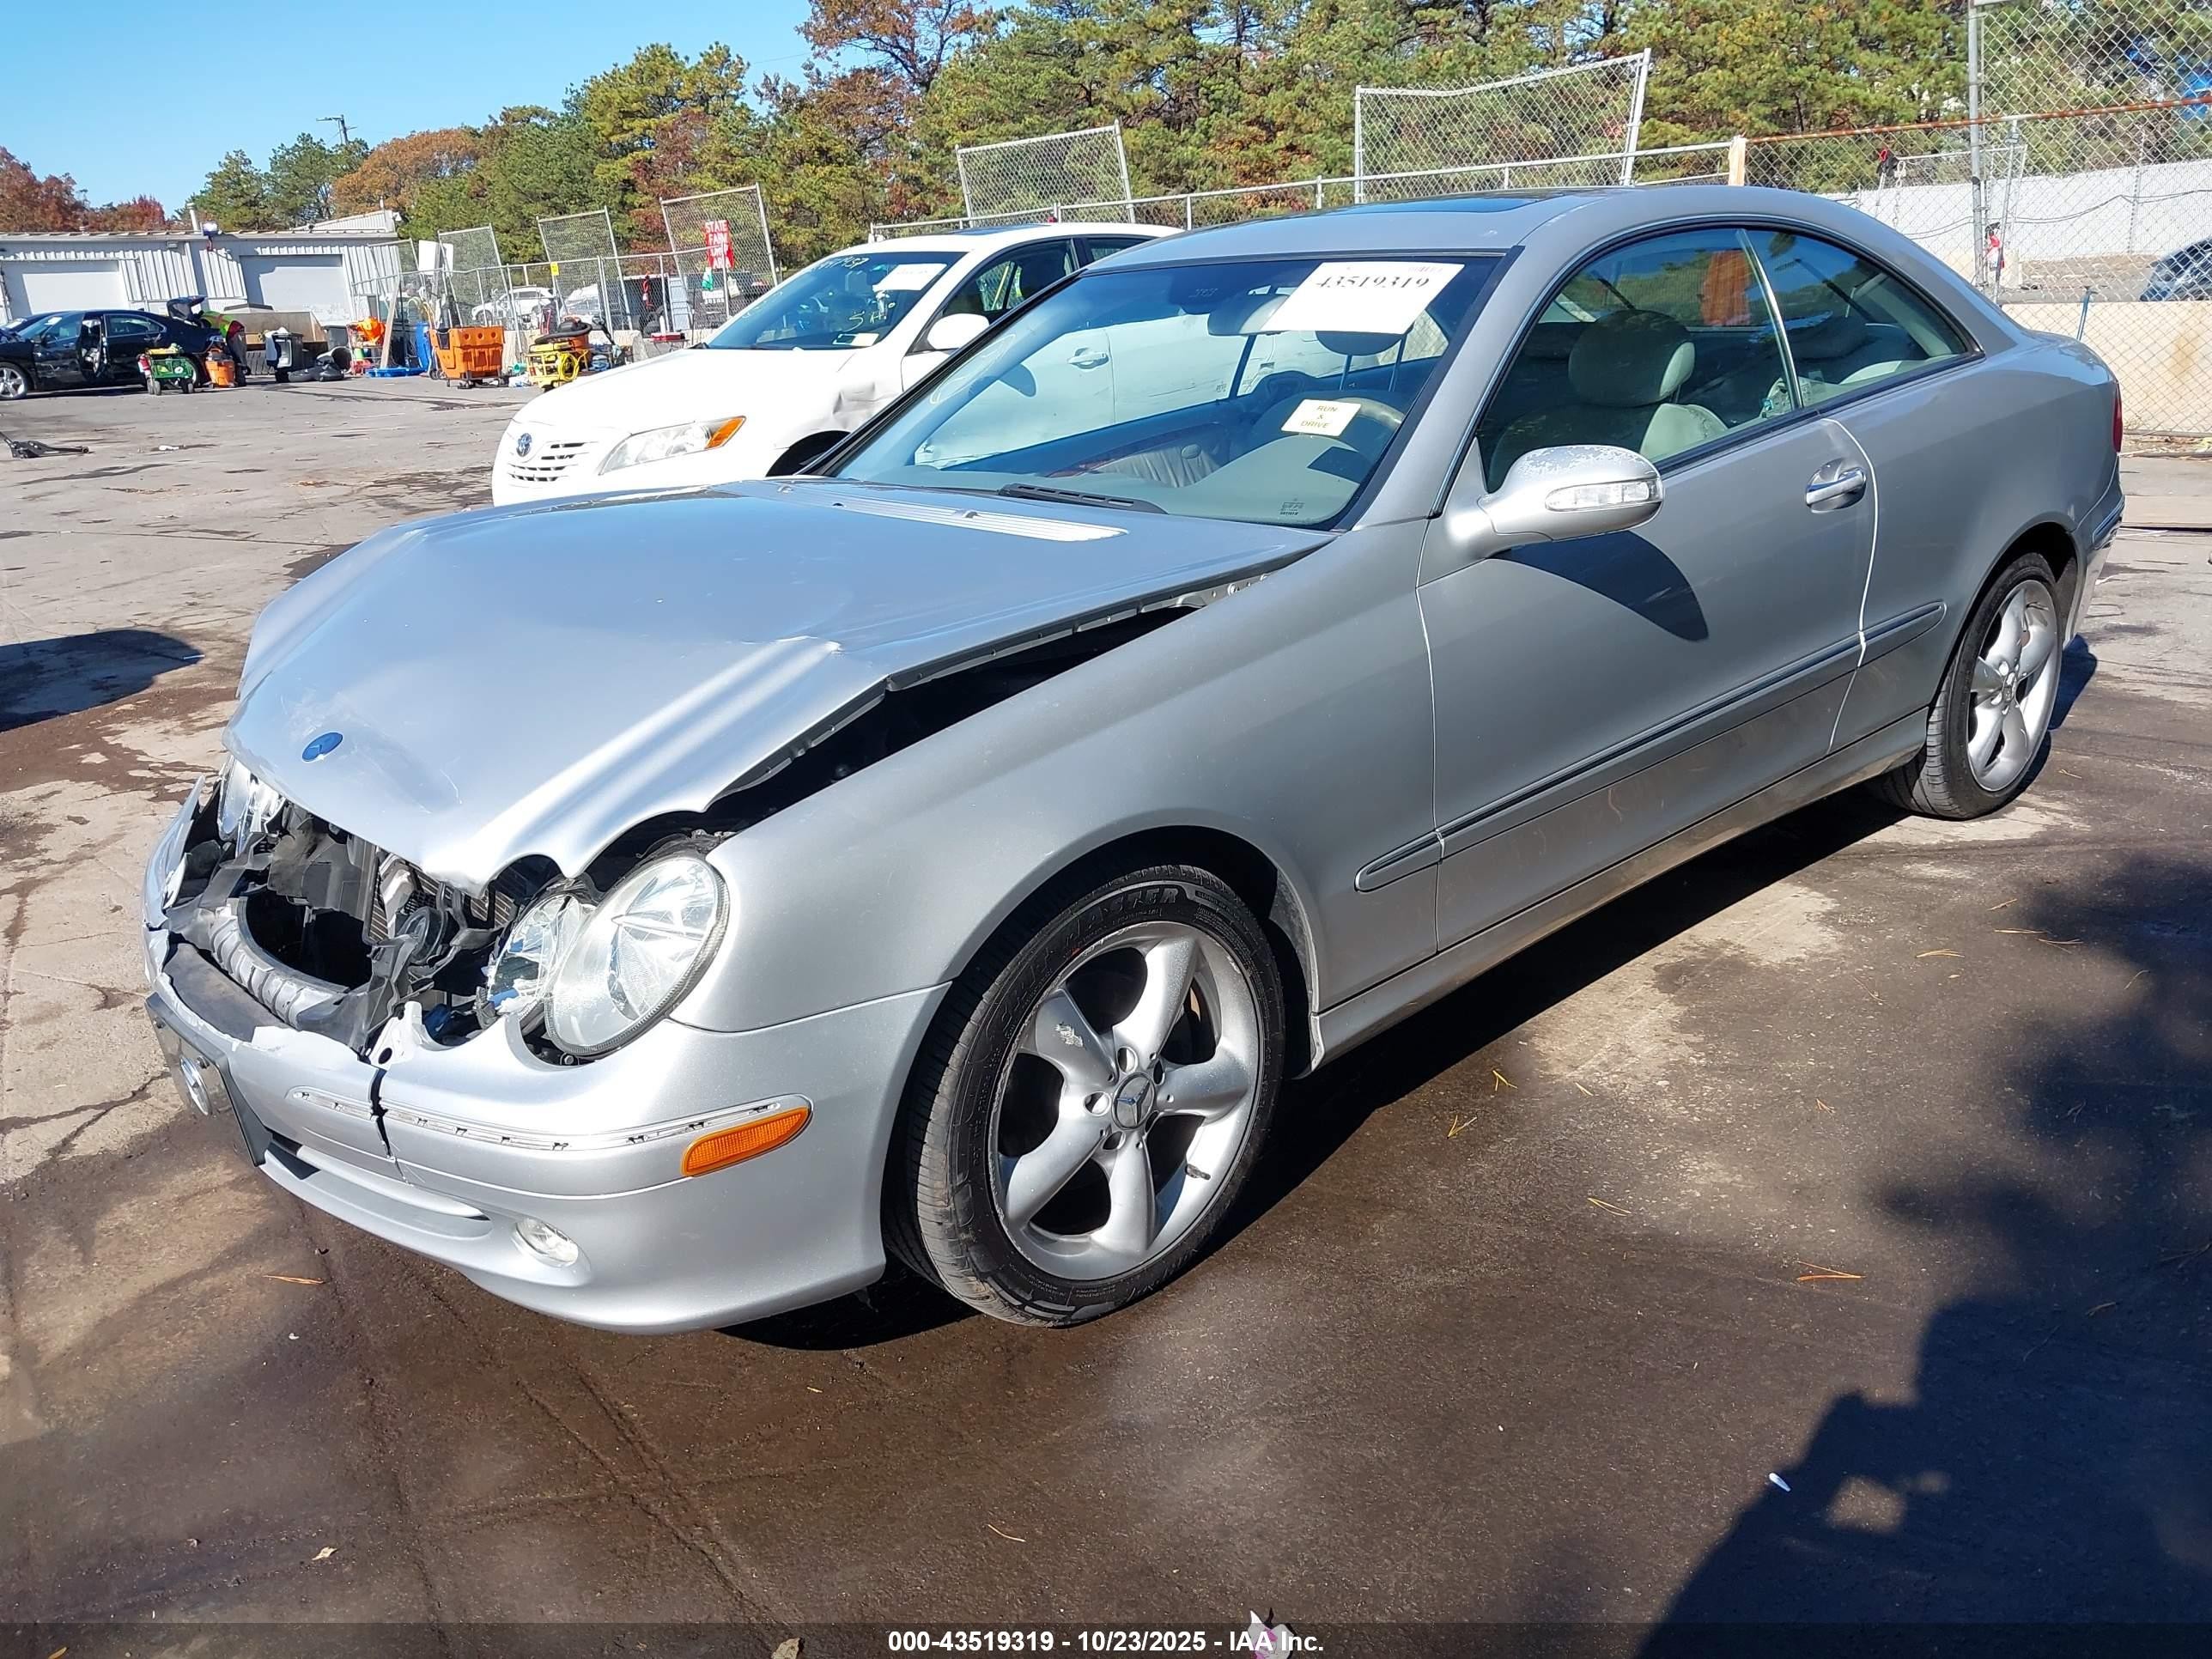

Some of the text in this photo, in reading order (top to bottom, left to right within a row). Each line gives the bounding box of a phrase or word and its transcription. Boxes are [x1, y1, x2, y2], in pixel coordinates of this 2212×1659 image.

[705, 220, 728, 233] STATE
[708, 232, 729, 246] FARM
[1316, 276, 1430, 289] 43519319
[1300, 420, 1330, 428] DRIVE
